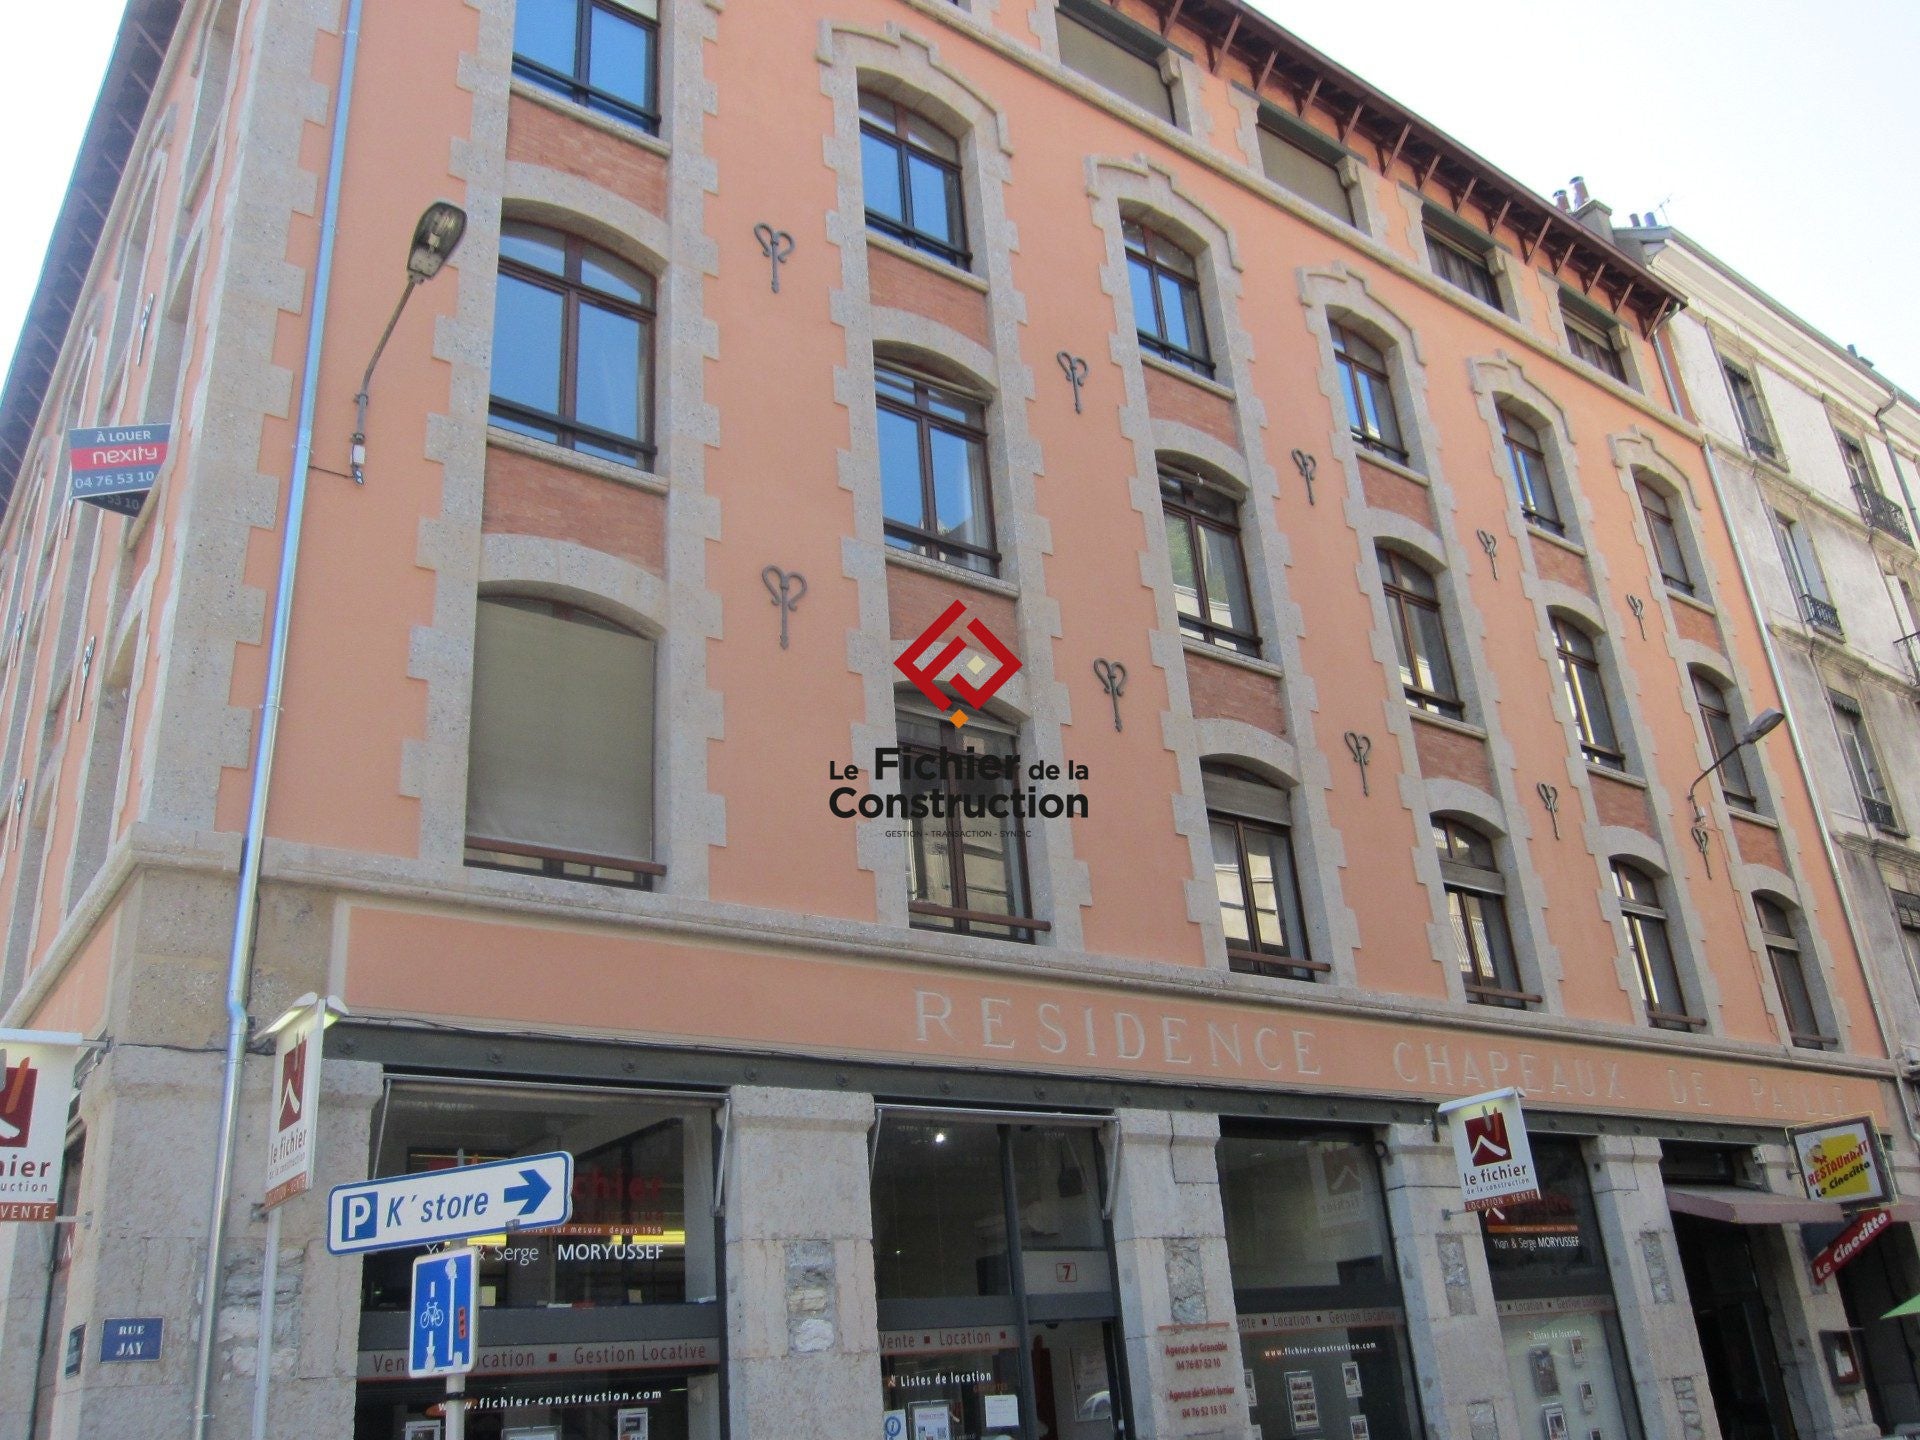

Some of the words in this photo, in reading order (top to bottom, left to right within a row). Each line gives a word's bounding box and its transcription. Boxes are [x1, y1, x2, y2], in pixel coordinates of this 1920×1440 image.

[96, 430, 105, 443] À
[109, 430, 151, 442] LOUER
[92, 446, 157, 465] nexity
[75, 477, 93, 489] 04
[96, 475, 113, 487] 76
[117, 473, 133, 485] 53
[138, 470, 154, 482] 10
[913, 988, 1322, 1075] RESIDENCE
[1392, 1041, 1626, 1099] CHAPEAUX
[1667, 1068, 1712, 1107] DE
[280, 1127, 307, 1160] fichier
[1463, 1172, 1477, 1186] le
[1480, 1163, 1527, 1183] fichier
[1485, 1177, 1530, 1191] construction
[1466, 1197, 1504, 1211] LOCATION
[1511, 1191, 1536, 1203] VENTE
[0, 1205, 51, 1219] VENTE
[1537, 1236, 1580, 1248] MORYUSSEF
[494, 1246, 539, 1266] Serge
[558, 1242, 664, 1261] MORYUSSEF
[1062, 1264, 1071, 1281] 7
[1272, 1312, 1311, 1327] Location
[118, 1325, 145, 1335] RUE
[879, 1333, 915, 1349] Vente
[939, 1329, 991, 1347] Location
[115, 1341, 144, 1356] JAY
[1199, 1341, 1228, 1353] Grenoble
[373, 1353, 408, 1373] Ven
[574, 1345, 635, 1365] Gestion
[642, 1342, 706, 1362] Locative
[900, 1375, 931, 1388] Listes
[935, 1373, 947, 1385] de
[950, 1370, 992, 1384] location
[437, 1388, 663, 1411] ww.fichier-construction.com
[1182, 1408, 1191, 1419] 04
